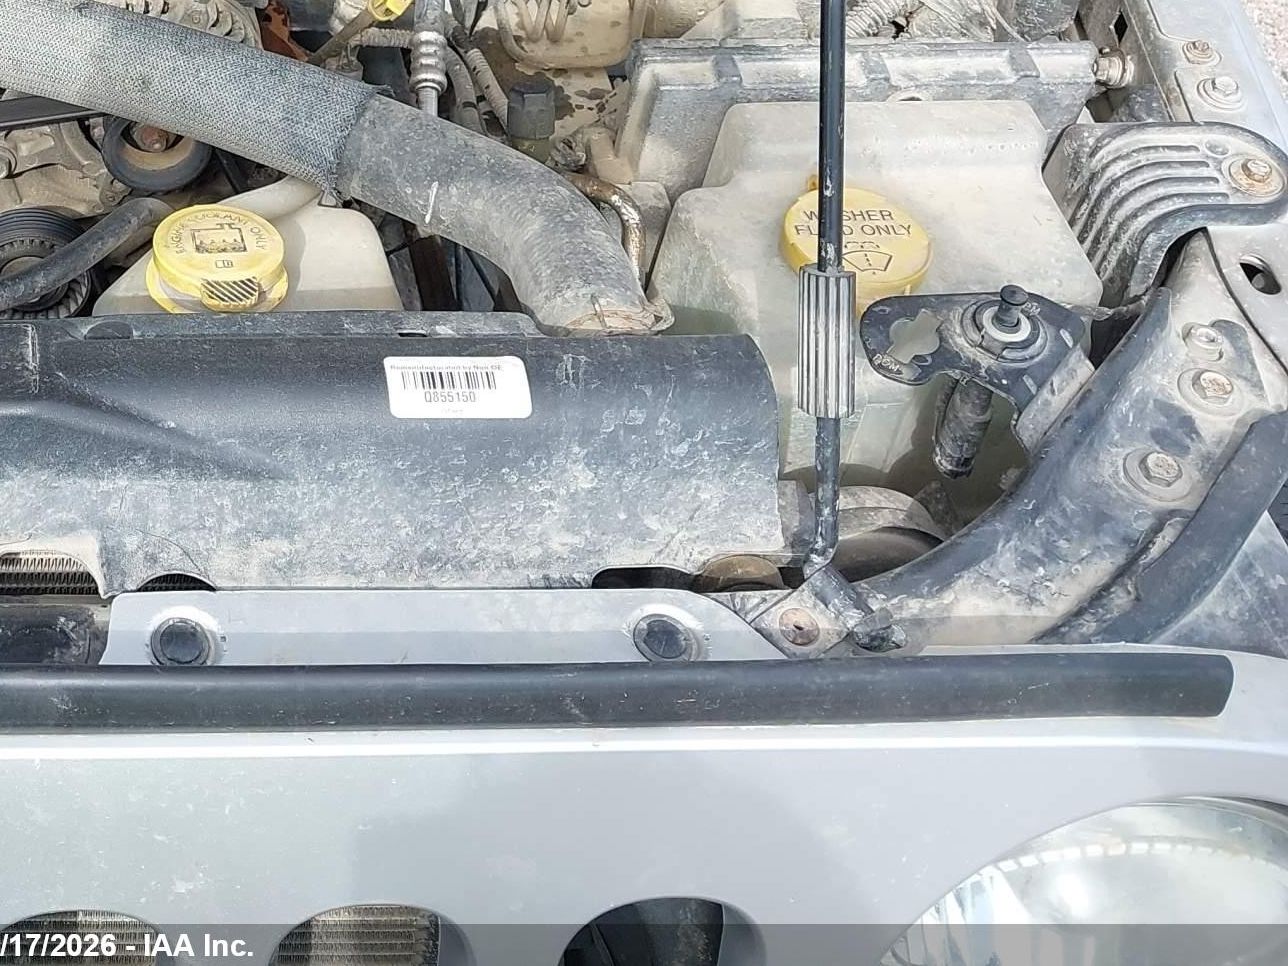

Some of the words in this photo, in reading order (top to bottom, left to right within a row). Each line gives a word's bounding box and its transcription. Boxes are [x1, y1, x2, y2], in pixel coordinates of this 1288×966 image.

[803, 209, 895, 221] WSHER
[794, 224, 854, 236] FLD
[862, 224, 912, 236] ONLY
[250, 226, 267, 251] ONLY
